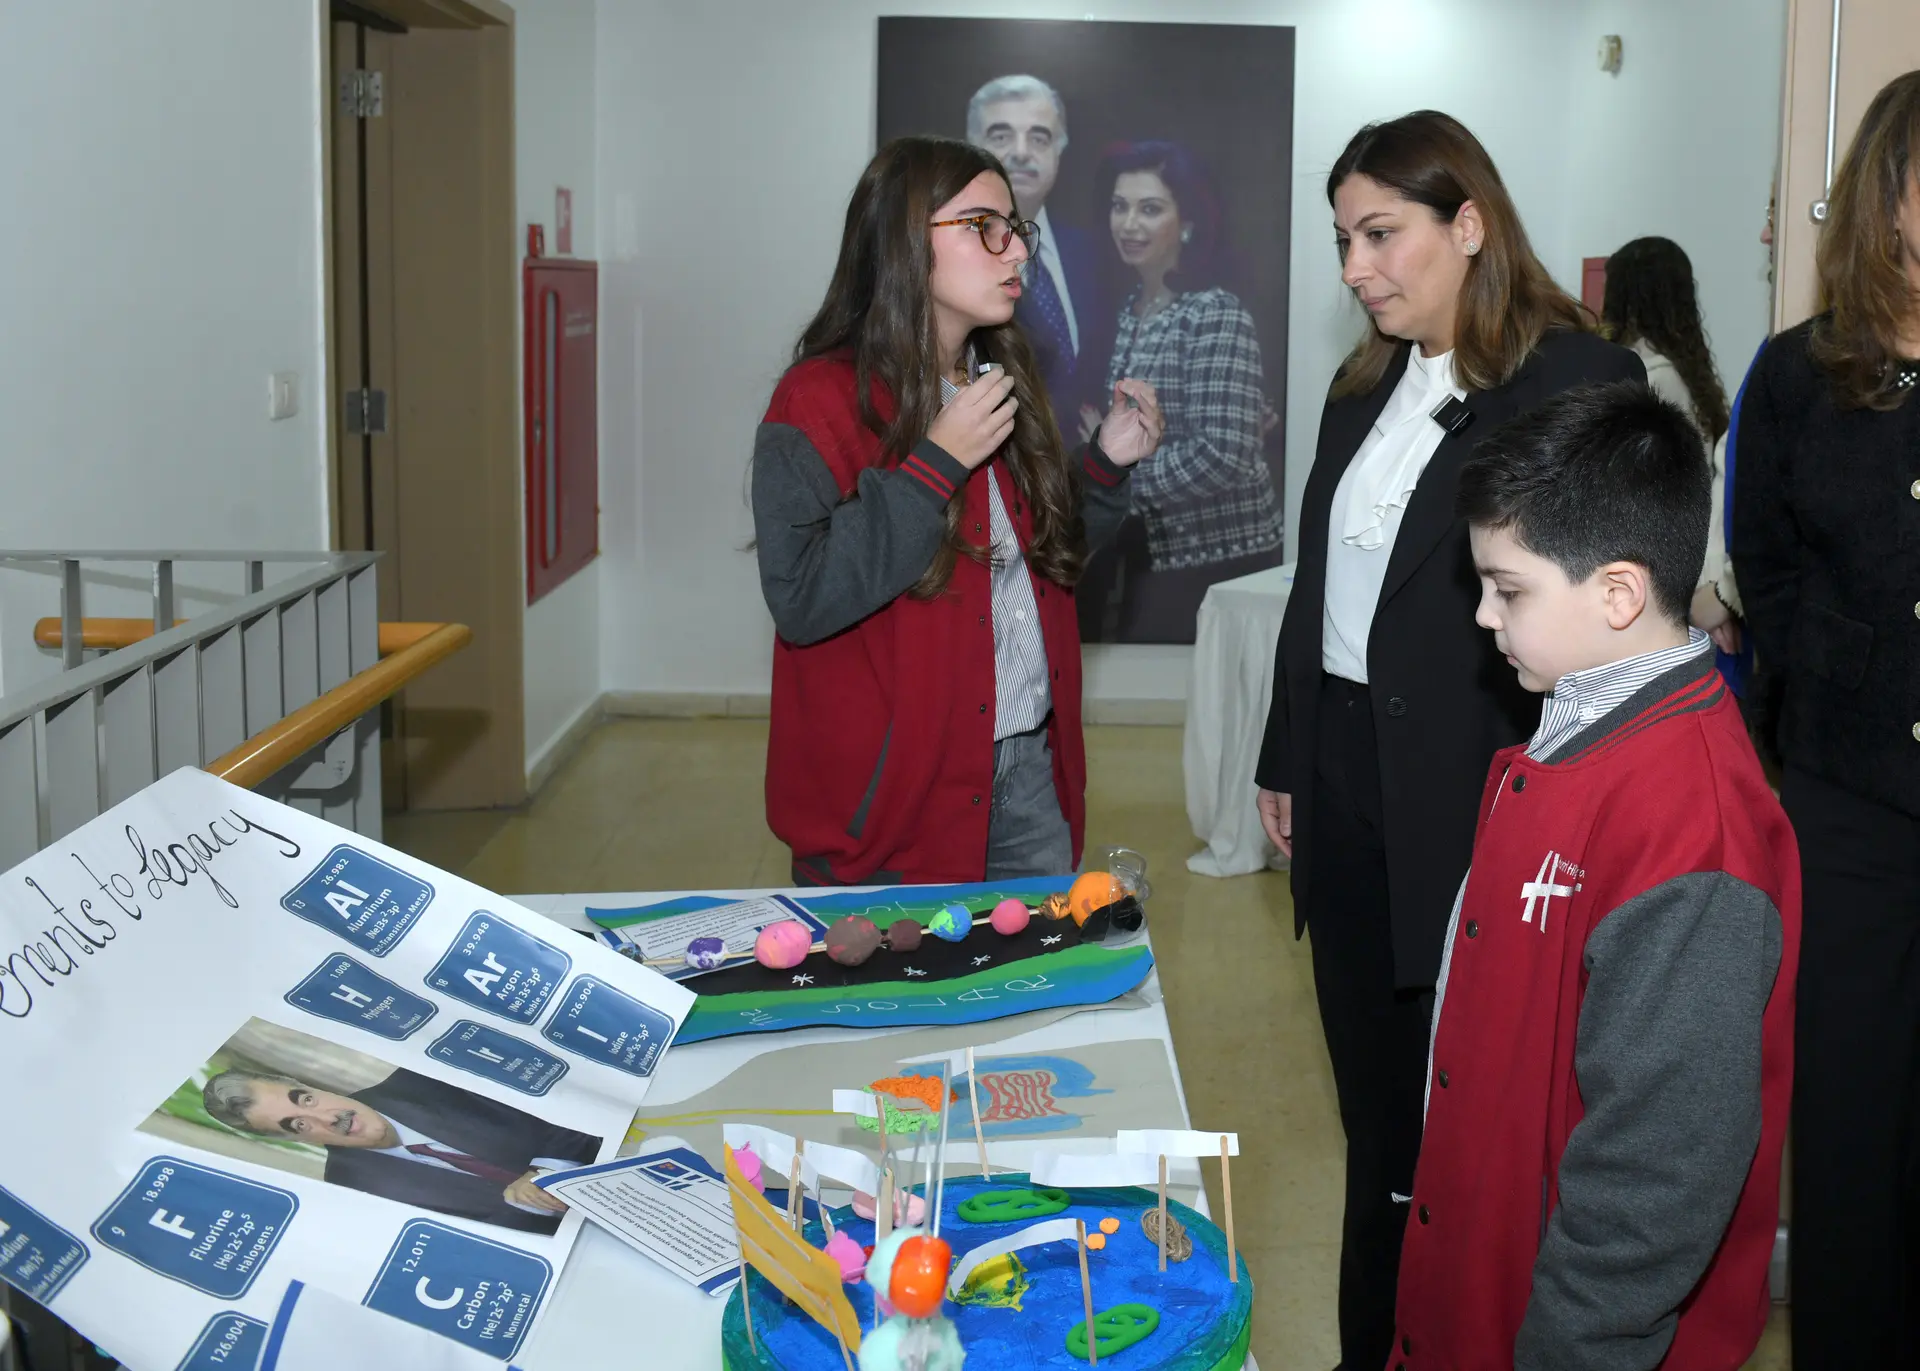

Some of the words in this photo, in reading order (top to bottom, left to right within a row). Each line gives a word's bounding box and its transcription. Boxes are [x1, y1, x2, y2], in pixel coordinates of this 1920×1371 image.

[71, 853, 141, 920] to
[126, 810, 300, 908] Legacy
[321, 858, 349, 886] 26.982
[292, 899, 306, 910] 13
[324, 880, 370, 920] Al
[347, 888, 392, 933] Aluminum
[409, 889, 429, 914] Metal
[463, 922, 489, 956] 39.948
[330, 961, 351, 979] 1.008
[436, 978, 449, 988] 18
[463, 952, 507, 996] Ar
[330, 984, 372, 1008] H
[496, 970, 523, 1000] Argon
[524, 997, 541, 1016] Noble
[540, 981, 552, 997] gas
[361, 995, 395, 1020] Hydrogen
[569, 982, 595, 1019] 126.904
[460, 1025, 480, 1041] 192.22
[552, 1031, 564, 1039] 53
[577, 1025, 608, 1043] I
[608, 1031, 628, 1055] Iodine
[440, 1047, 453, 1056] 77
[467, 1047, 504, 1063] Ir
[142, 1167, 175, 1203] 18.998
[111, 1226, 126, 1237] 9
[149, 1208, 195, 1240] F
[189, 1209, 234, 1261] Fluorine
[0, 1233, 30, 1268] adium
[236, 1225, 274, 1273] Halogens
[402, 1233, 431, 1273] 12.011
[651, 1234, 671, 1246] system
[670, 1245, 695, 1260] digestive
[713, 1233, 739, 1248] ndividuals
[58, 1244, 80, 1267] Metal
[415, 1275, 464, 1310] C
[457, 1281, 490, 1329] Carbon
[503, 1293, 532, 1339] Nonmetal
[210, 1319, 248, 1363] 126.904
